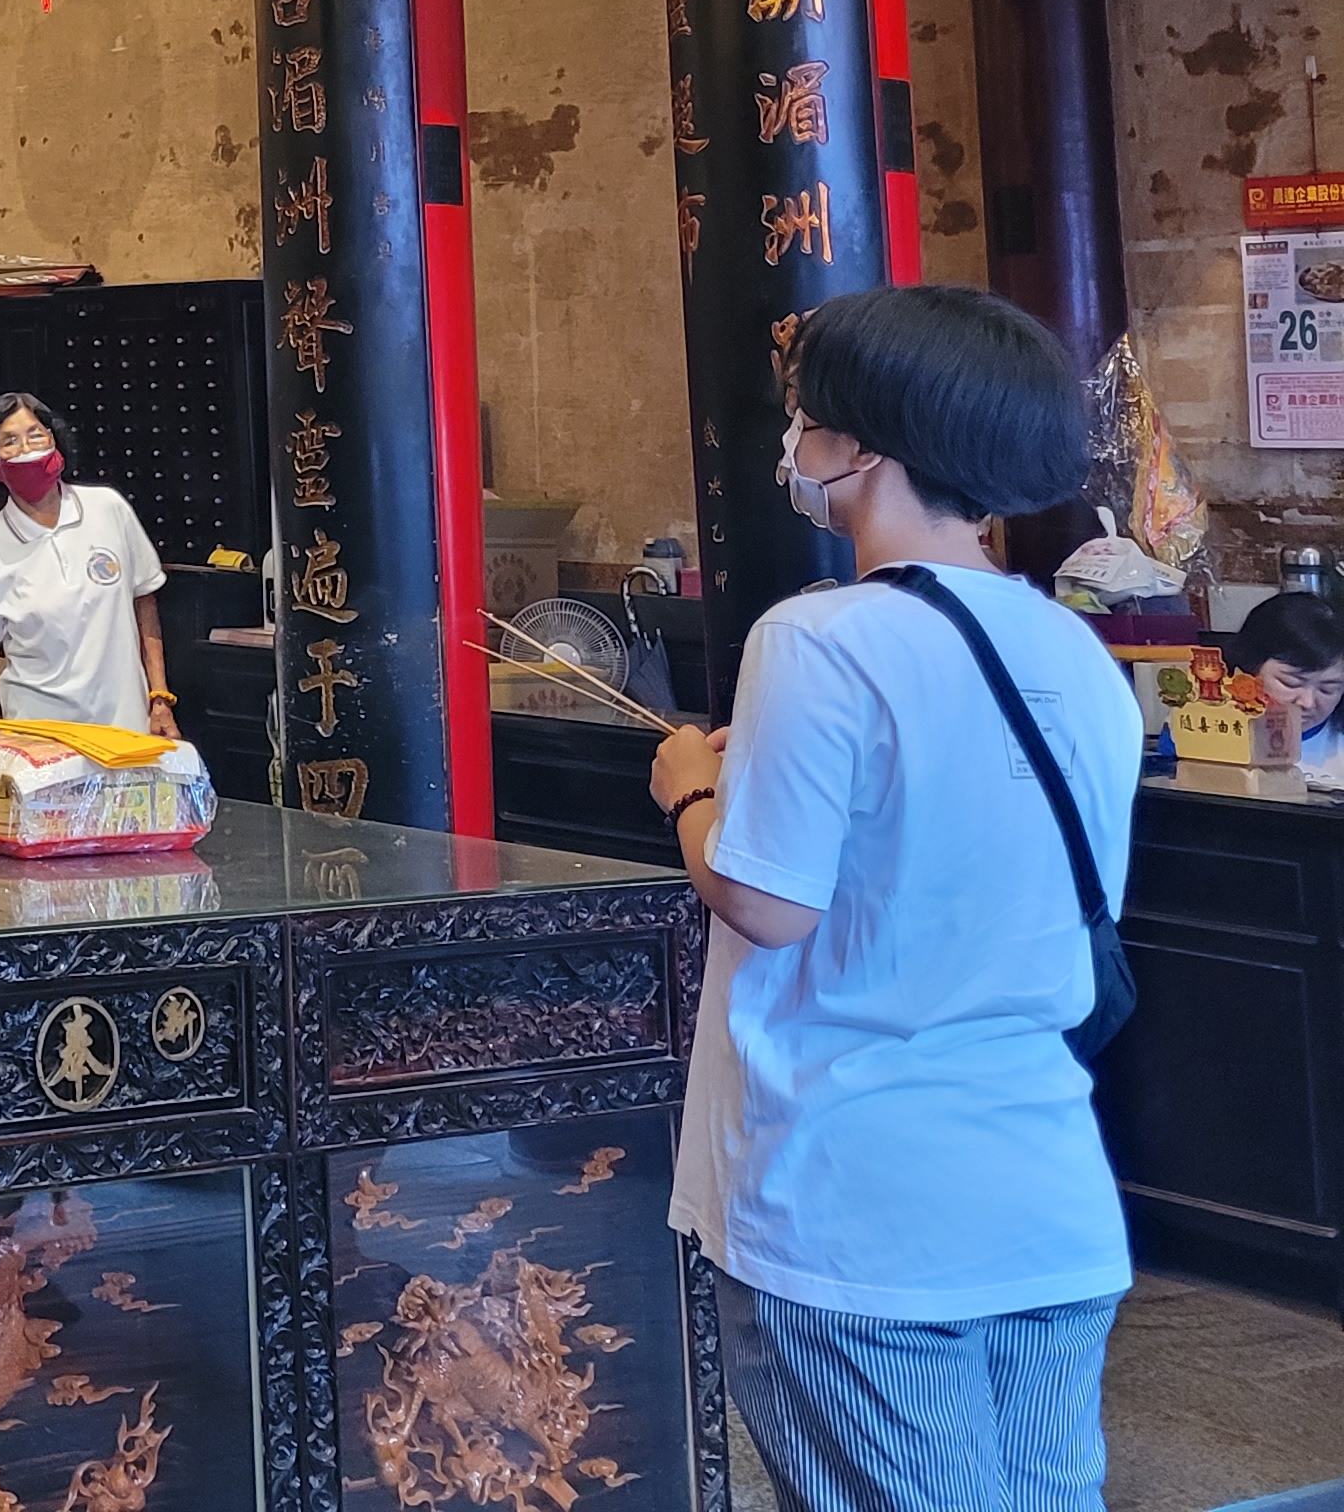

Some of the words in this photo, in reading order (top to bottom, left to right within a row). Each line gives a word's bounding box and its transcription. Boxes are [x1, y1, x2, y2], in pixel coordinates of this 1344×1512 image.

[1279, 310, 1318, 351] 26
[1179, 714, 1244, 737] 隨喜油香
